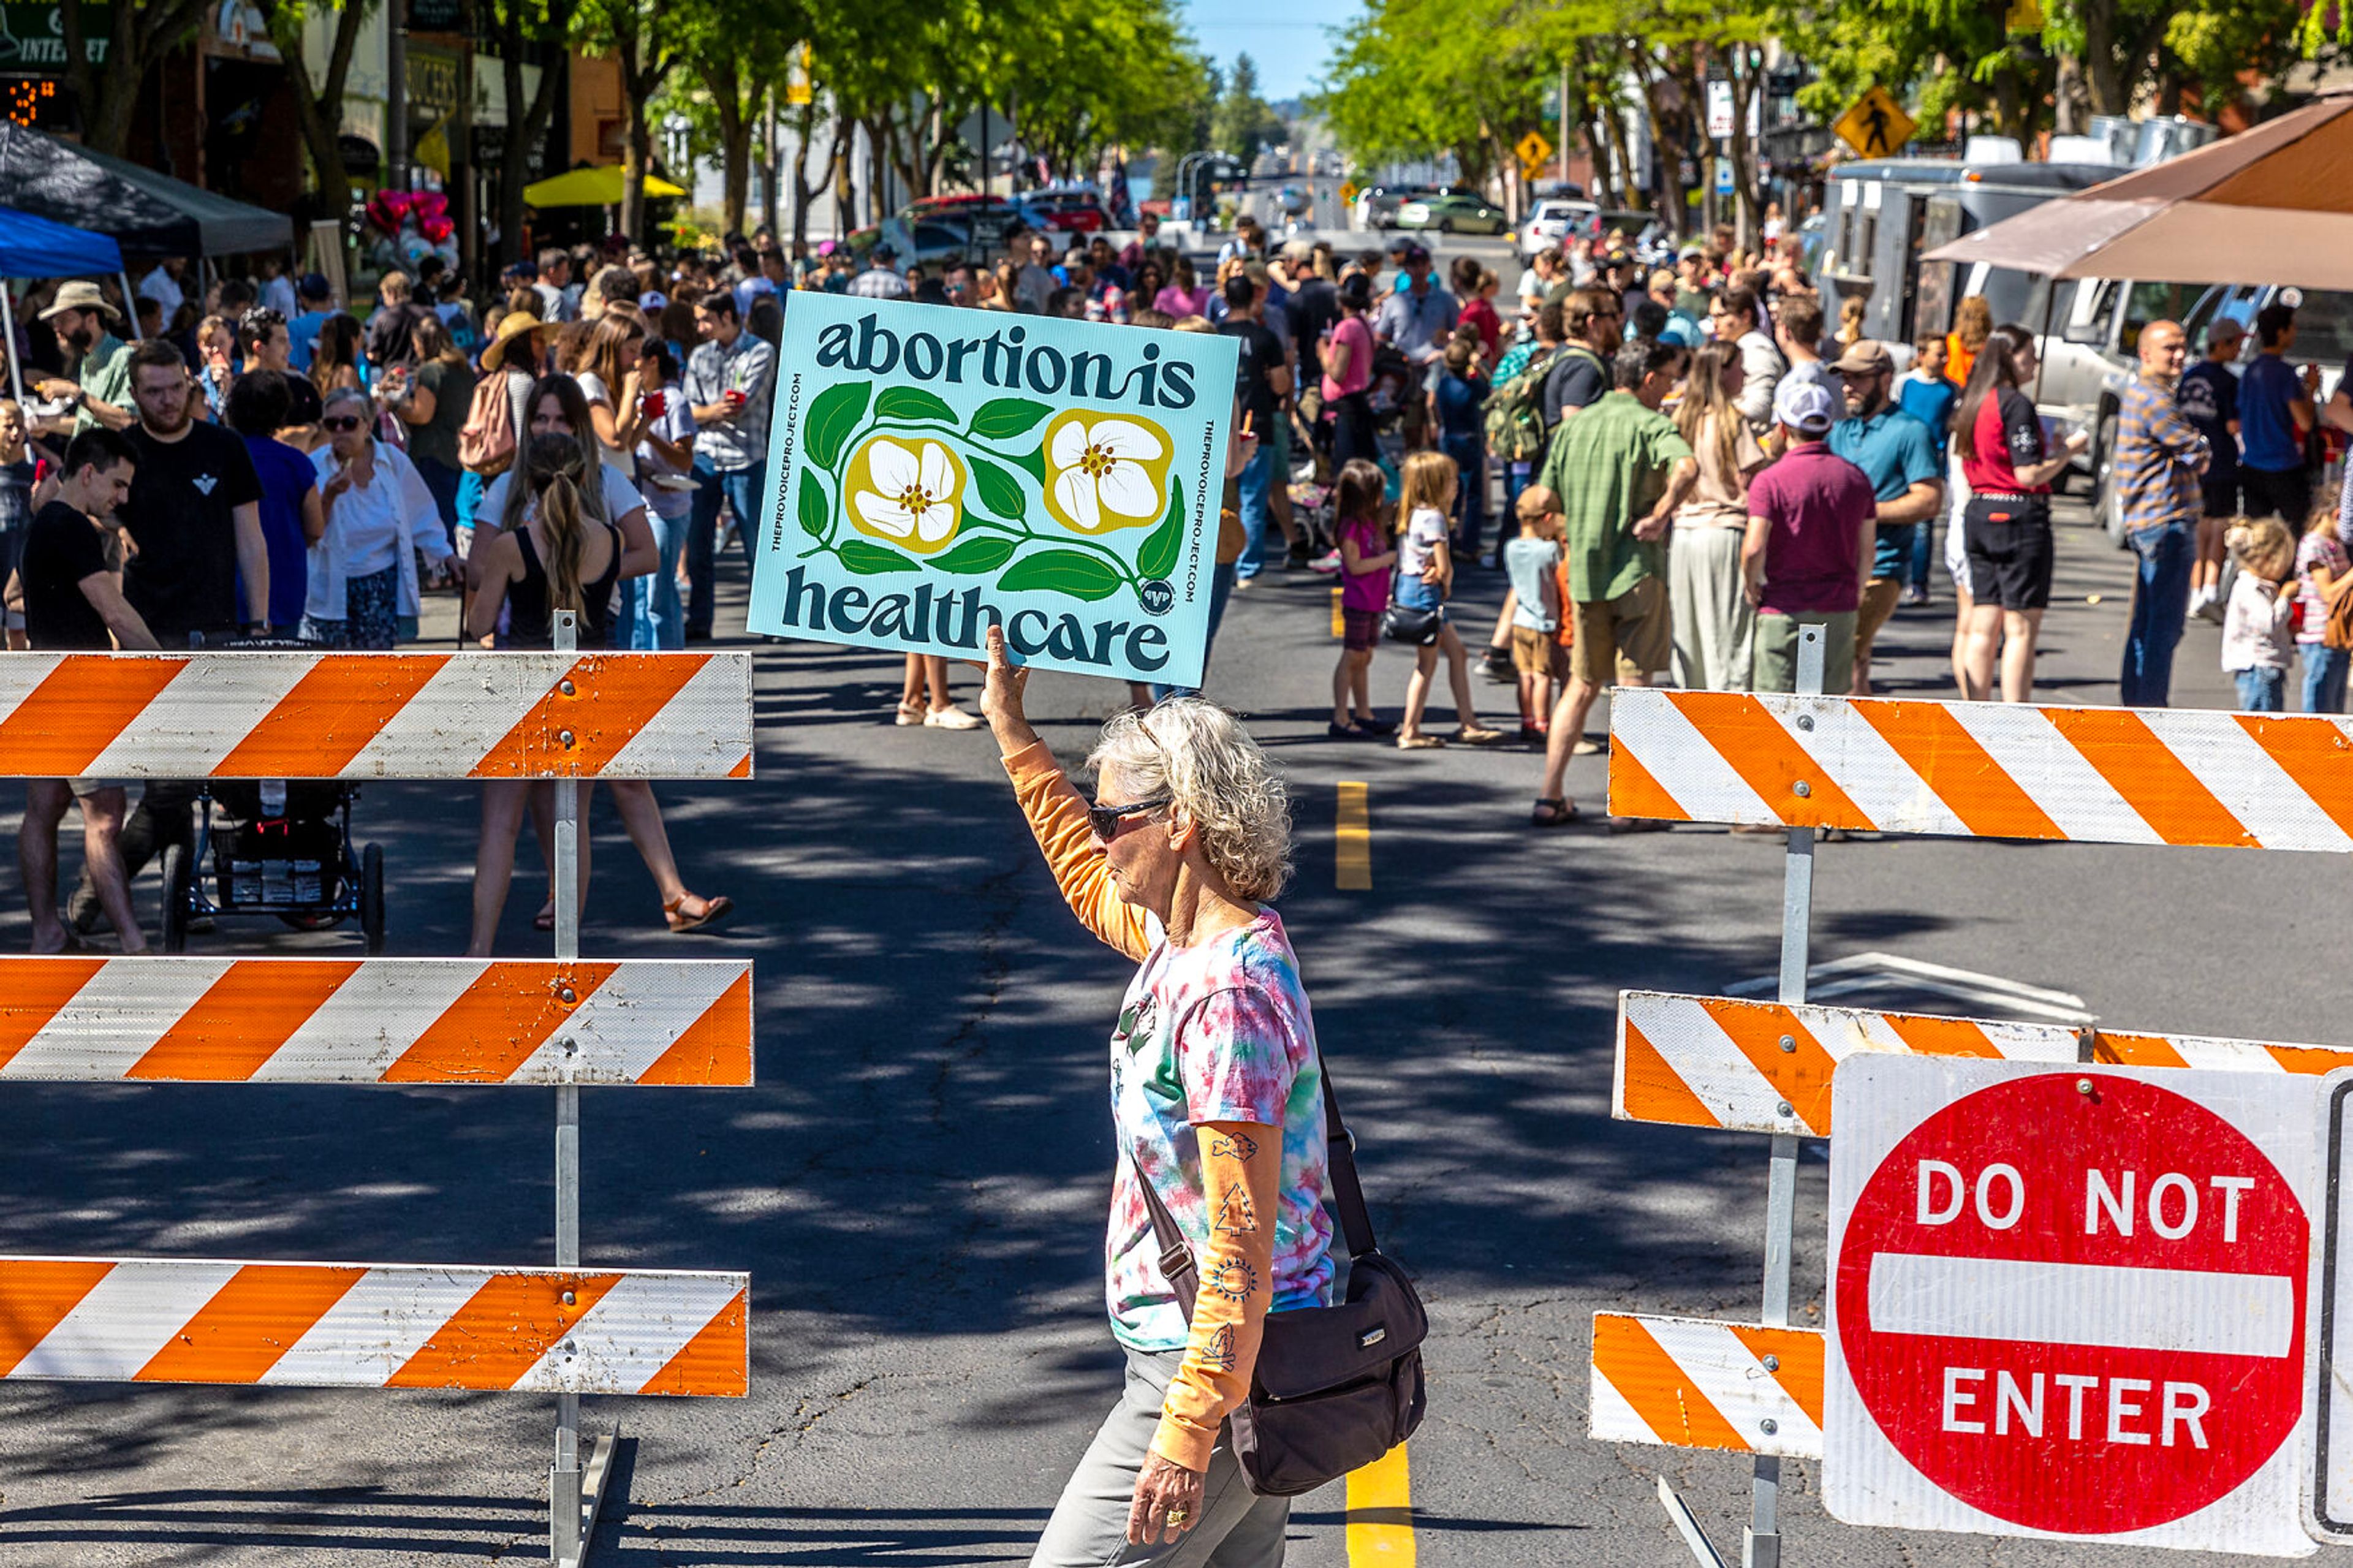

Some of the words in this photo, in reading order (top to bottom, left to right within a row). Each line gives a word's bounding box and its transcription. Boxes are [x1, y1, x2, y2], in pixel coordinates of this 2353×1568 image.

[20, 37, 109, 62] INTEET
[816, 312, 1126, 401] abortion
[1134, 343, 1196, 409] is
[771, 373, 801, 552] THEPROVOICEPROJECT.COM
[1185, 419, 1214, 604] THEPROVOICEPROJECT.COM
[1916, 1159, 2025, 1230] DO
[2085, 1168, 2255, 1243] NOT
[1941, 1366, 2210, 1449] ENTER
